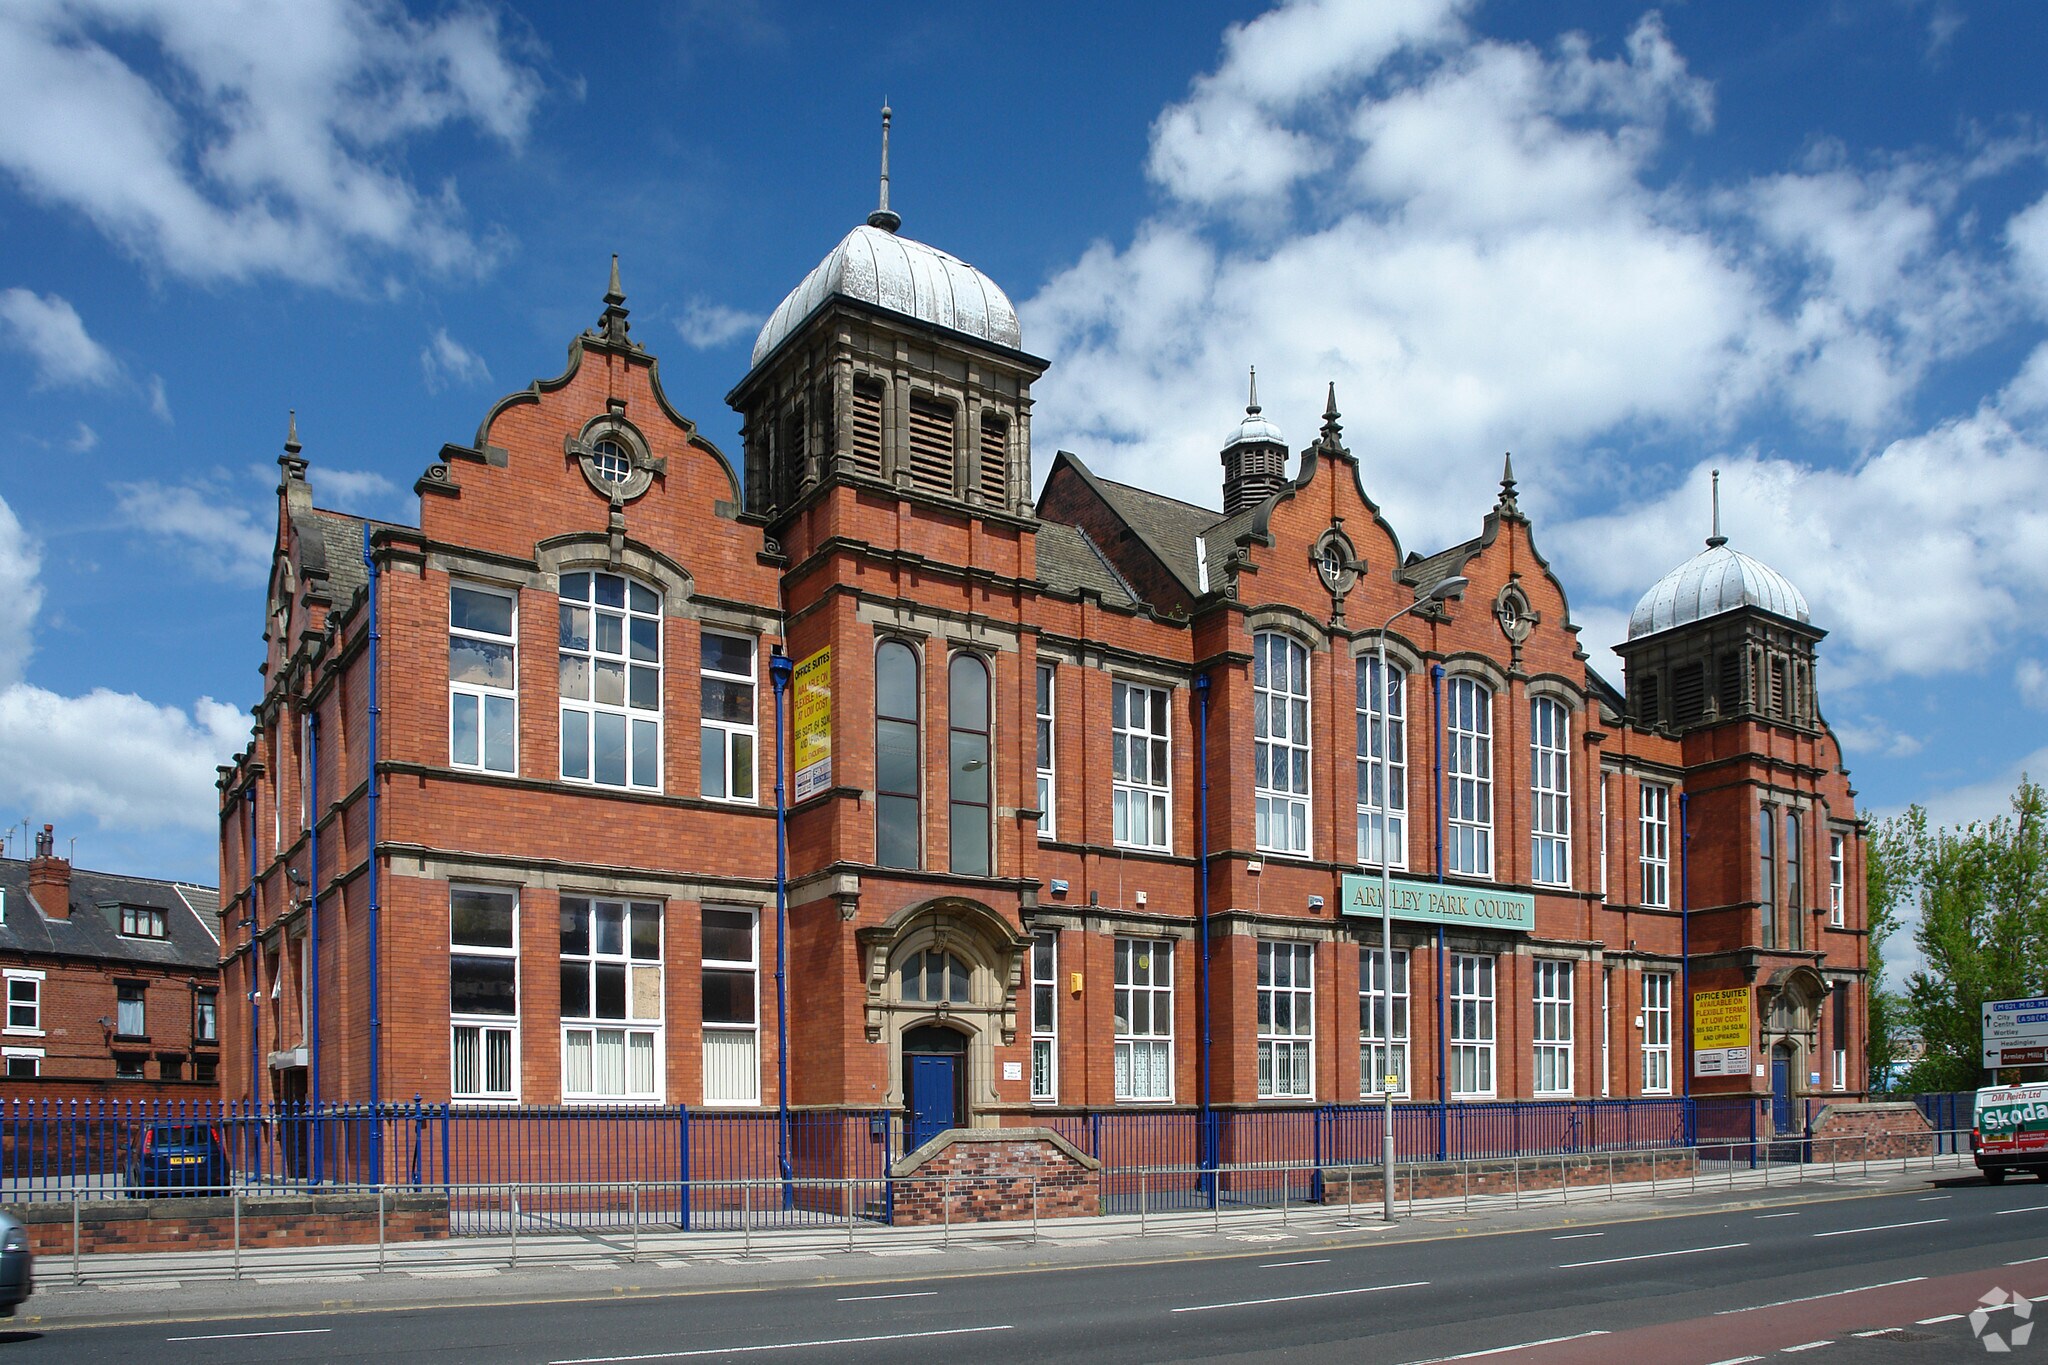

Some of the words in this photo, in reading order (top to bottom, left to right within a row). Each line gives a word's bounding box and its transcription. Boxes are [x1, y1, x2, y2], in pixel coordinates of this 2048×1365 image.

[795, 662, 811, 680] OFFICE
[812, 651, 830, 669] SUITES
[795, 691, 814, 711] FLEXIBLE
[804, 704, 814, 718] LOW
[815, 697, 828, 712] COST
[1428, 892, 1469, 916] PARK
[1474, 898, 1526, 921] COURT
[1695, 992, 1720, 1001] OFFICE
[1721, 989, 1747, 998] SUITES
[1700, 999, 1732, 1007] AVAILABLE
[1696, 1008, 1724, 1017] FLEXIBLE
[1725, 1006, 1747, 1014] TERMS
[1991, 1093, 2004, 1102] DM
[2029, 1090, 2042, 1099] Ltd
[1984, 1102, 2048, 1130] Skoda
